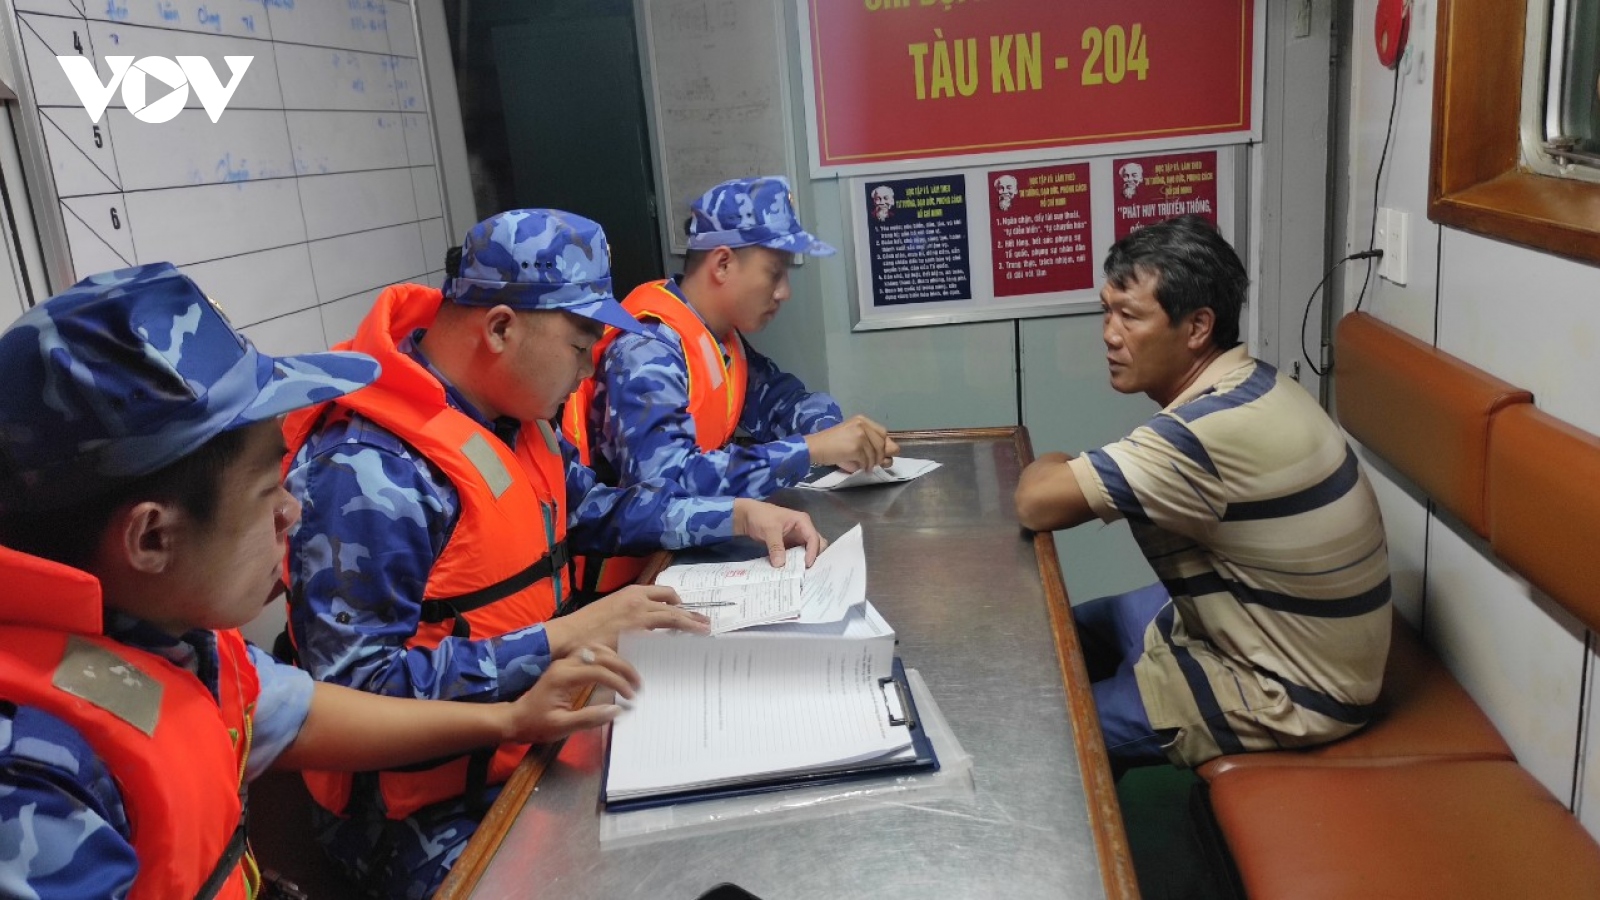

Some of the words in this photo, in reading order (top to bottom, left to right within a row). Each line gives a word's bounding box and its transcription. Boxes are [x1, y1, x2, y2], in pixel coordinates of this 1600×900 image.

[73, 31, 83, 54] 4
[909, 28, 978, 100] TÀU
[990, 32, 1042, 94] KN
[1055, 57, 1068, 69] -
[1081, 23, 1149, 85] 204
[93, 125, 103, 148] 5
[110, 207, 121, 230] 6
[1142, 203, 1156, 218] HUY
